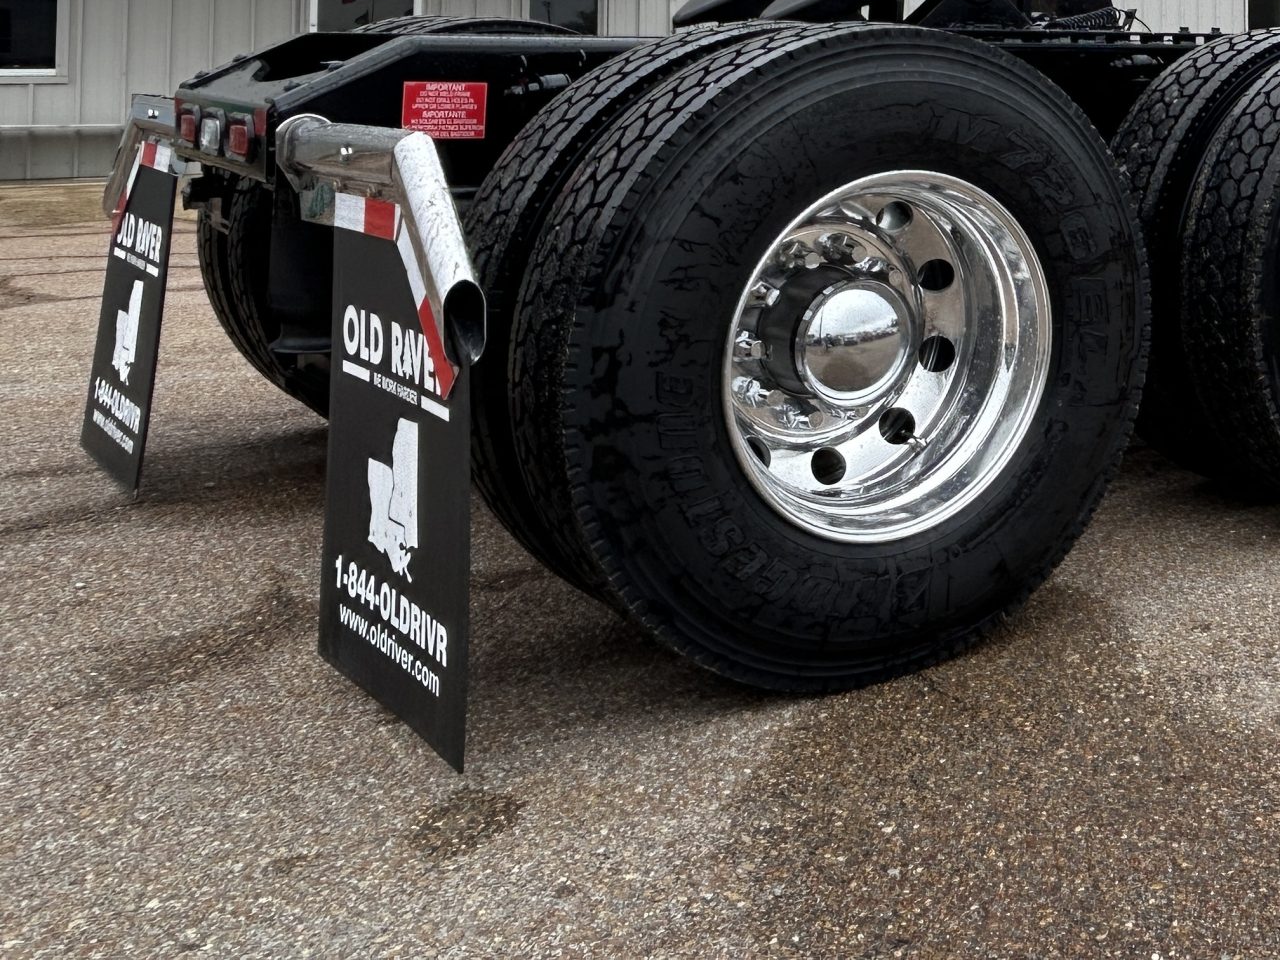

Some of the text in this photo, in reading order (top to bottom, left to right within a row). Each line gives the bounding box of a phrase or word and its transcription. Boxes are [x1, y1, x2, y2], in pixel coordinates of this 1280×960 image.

[422, 110, 466, 118] IMPORTANTE
[426, 83, 466, 91] IMPORTANT
[343, 304, 384, 365] OLD
[335, 554, 448, 668] 1-844-OLDRIVR
[339, 603, 440, 697] www.oldriver.com
